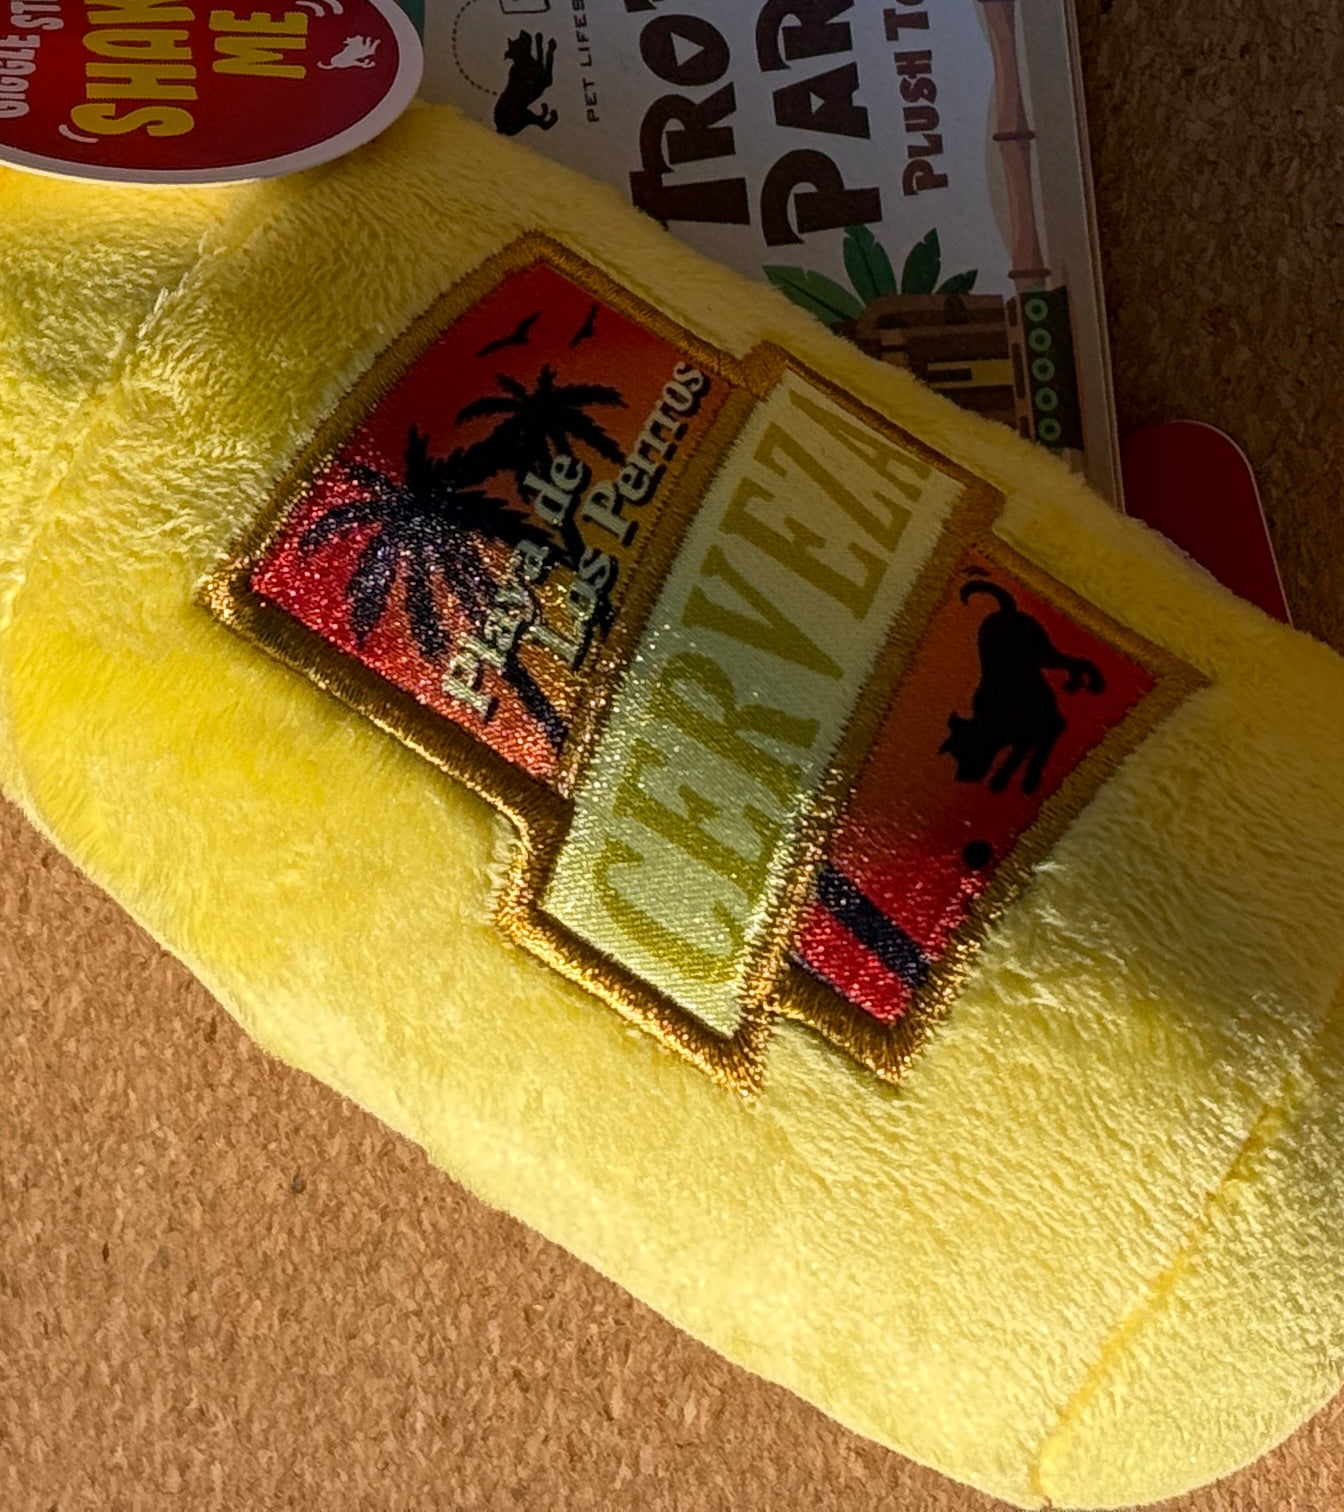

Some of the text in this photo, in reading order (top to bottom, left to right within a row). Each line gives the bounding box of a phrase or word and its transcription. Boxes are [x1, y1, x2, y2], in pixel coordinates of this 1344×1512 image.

[208, 9, 309, 80] ME
[582, 77, 600, 124] PET
[892, 49, 949, 197] PLUSH
[441, 451, 585, 721] Playa de
[529, 545, 612, 664] Los
[590, 387, 936, 986] CERVEZA
